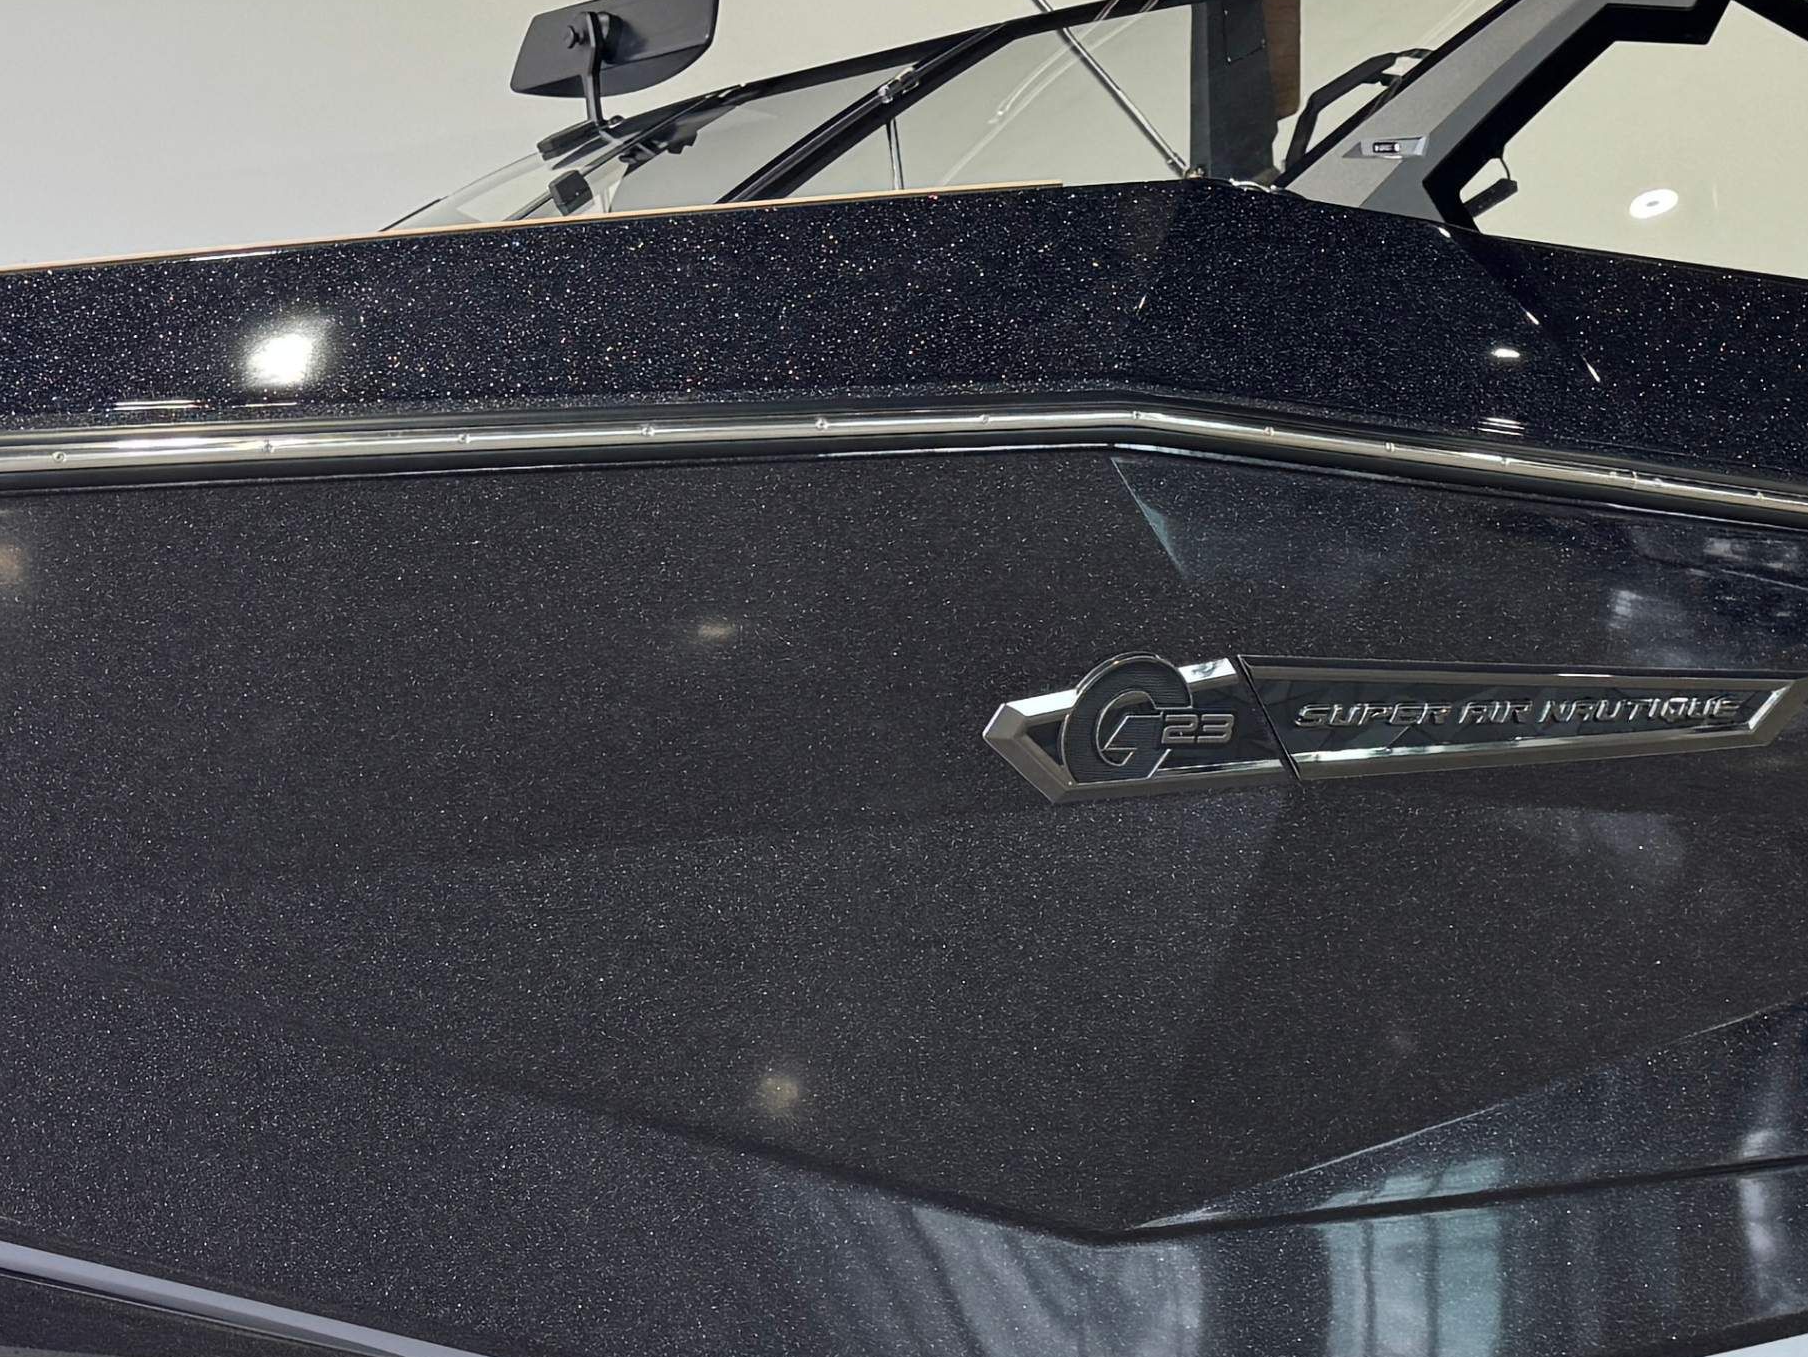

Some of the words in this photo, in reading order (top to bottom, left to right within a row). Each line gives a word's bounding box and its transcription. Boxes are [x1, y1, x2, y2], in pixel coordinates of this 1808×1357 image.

[1294, 702, 1453, 727] SUPER
[1457, 700, 1533, 725] AIR
[1538, 697, 1742, 724] NAUTIQUE
